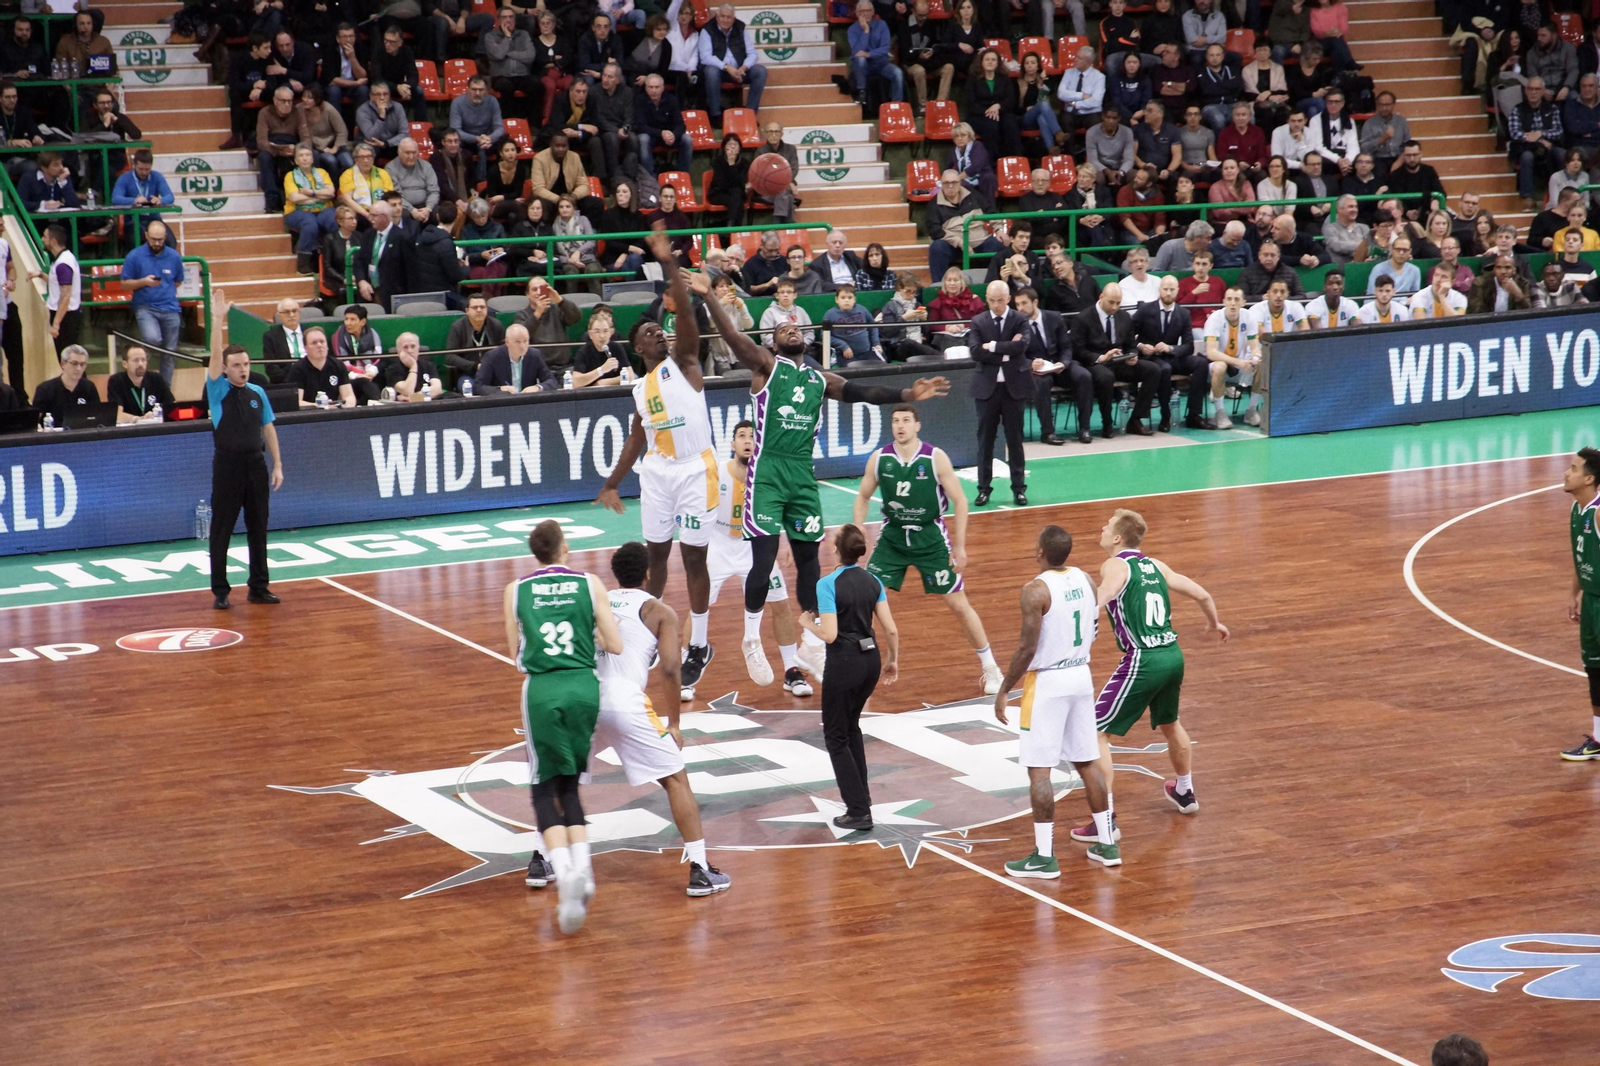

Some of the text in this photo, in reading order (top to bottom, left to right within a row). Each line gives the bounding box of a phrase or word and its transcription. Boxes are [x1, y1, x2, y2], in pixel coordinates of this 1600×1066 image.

[1388, 335, 1531, 406] WIDEN
[647, 395, 665, 415] 16
[369, 421, 542, 498] WIDEN
[895, 480, 912, 497] 12
[684, 513, 701, 530] 16
[732, 504, 743, 519] 8
[804, 515, 821, 533] 26
[934, 569, 951, 586] 12
[531, 581, 579, 596] WILTJER
[1145, 591, 1166, 627] 10
[538, 620, 575, 656] 33
[1072, 609, 1083, 648] 1
[135, 629, 220, 650] 7 DAYS
